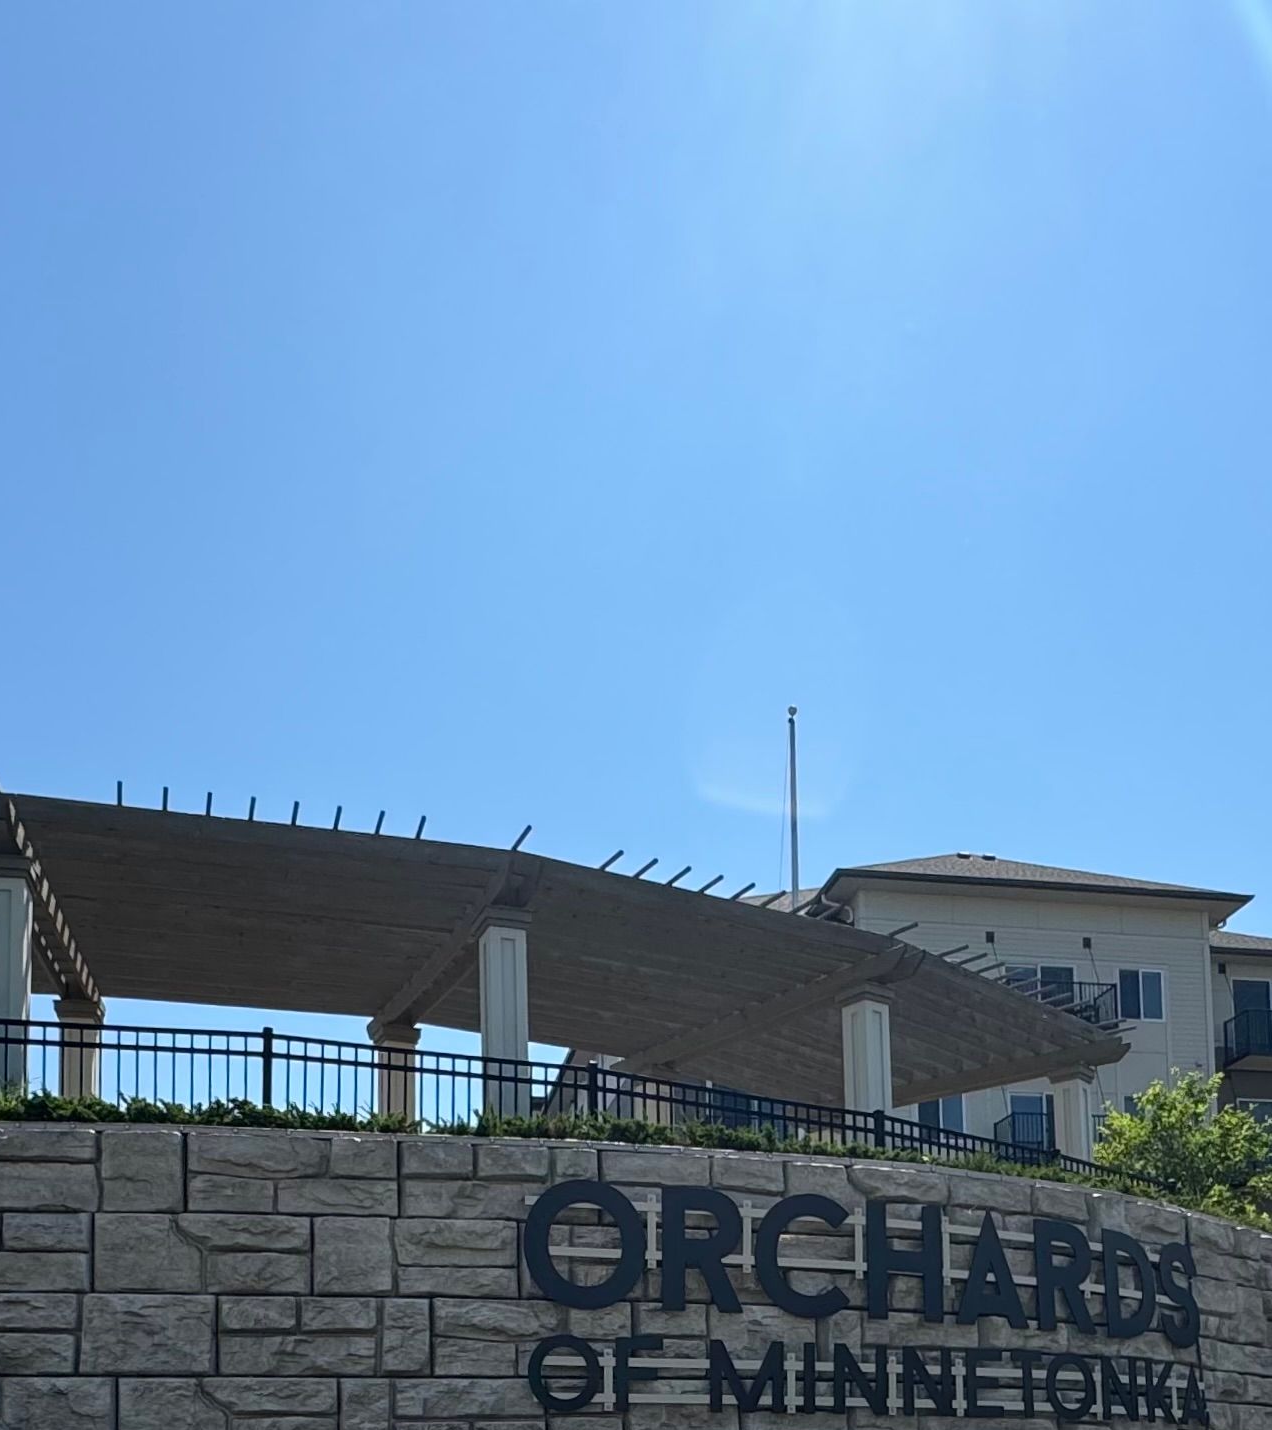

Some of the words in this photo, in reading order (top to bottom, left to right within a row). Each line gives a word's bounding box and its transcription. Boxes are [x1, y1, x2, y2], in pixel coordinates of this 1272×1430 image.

[524, 1179, 1201, 1348] ORCHARDS
[528, 1334, 663, 1412] OF
[709, 1339, 1207, 1425] MINNETONKA
